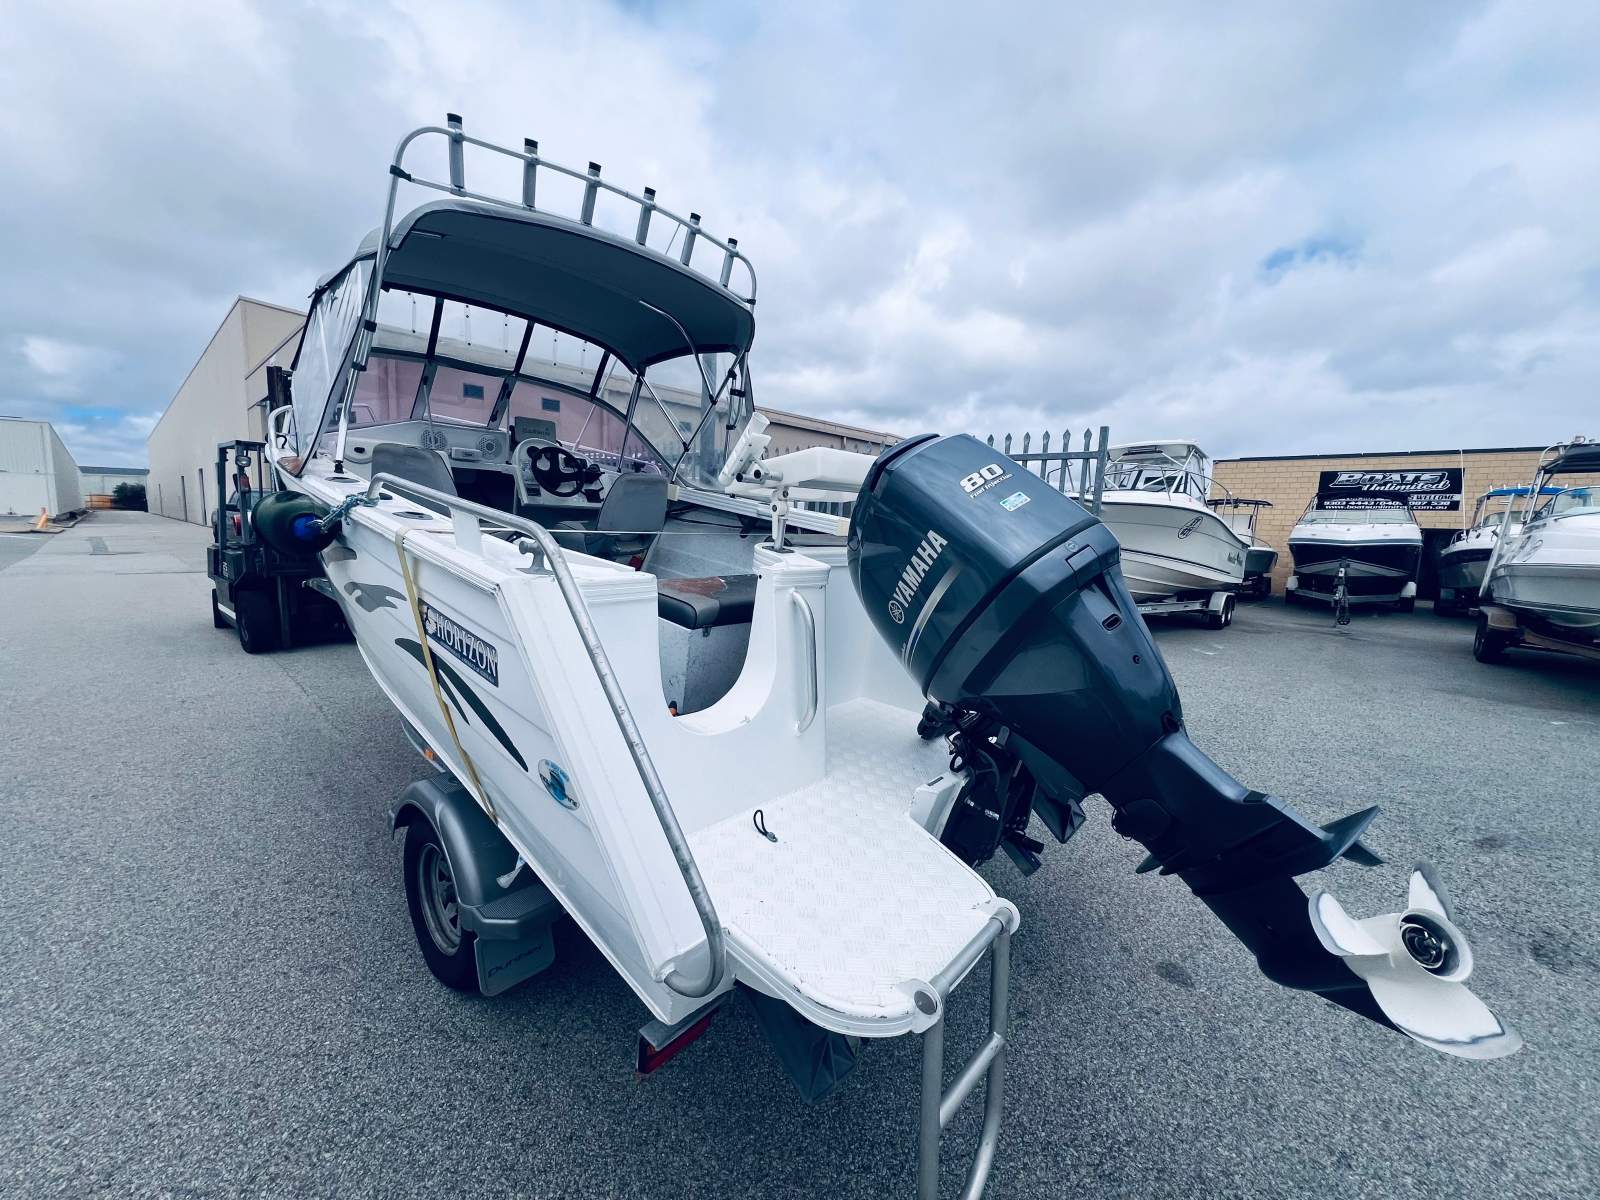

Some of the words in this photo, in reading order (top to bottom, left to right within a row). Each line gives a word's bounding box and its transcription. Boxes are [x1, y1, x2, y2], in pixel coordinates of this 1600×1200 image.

[959, 463, 1004, 493] 80
[969, 487, 985, 499] Fuel
[985, 472, 1014, 490] Injection
[1331, 472, 1446, 487] BOATS
[1361, 480, 1450, 492] Unlimited
[893, 530, 948, 608] YAMAHA
[436, 612, 499, 677] HORIZON
